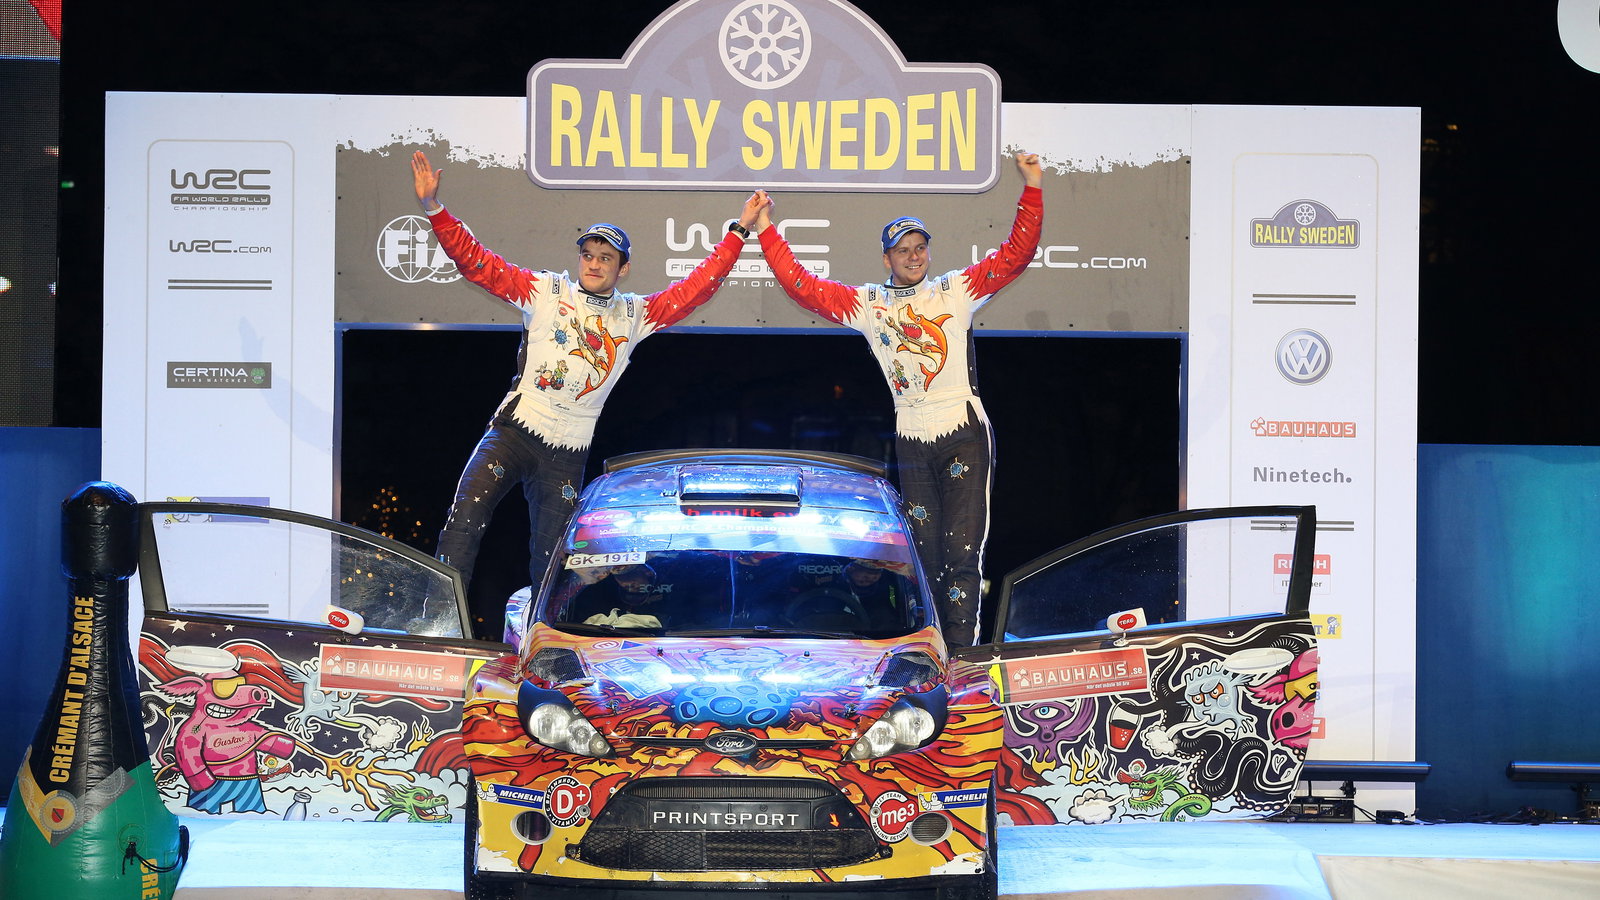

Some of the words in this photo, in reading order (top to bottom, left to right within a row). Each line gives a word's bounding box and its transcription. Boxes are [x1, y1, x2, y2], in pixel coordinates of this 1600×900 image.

[549, 83, 721, 169] RALLY
[741, 87, 977, 171] SWEDEN
[170, 168, 271, 190] WRC
[1255, 223, 1296, 244] RALLY
[1299, 224, 1355, 245] SWEDEN
[173, 367, 249, 377] CERTINA
[1268, 423, 1355, 435] BAUHAUS
[569, 553, 642, 566] GK-1913
[67, 595, 95, 687] D'ALSACE
[49, 688, 86, 783] CRÉMANT
[715, 735, 745, 749] Ford
[500, 789, 544, 803] MICHELIN
[944, 792, 988, 803] MICHELIN
[653, 811, 800, 826] PRINTSPORT
